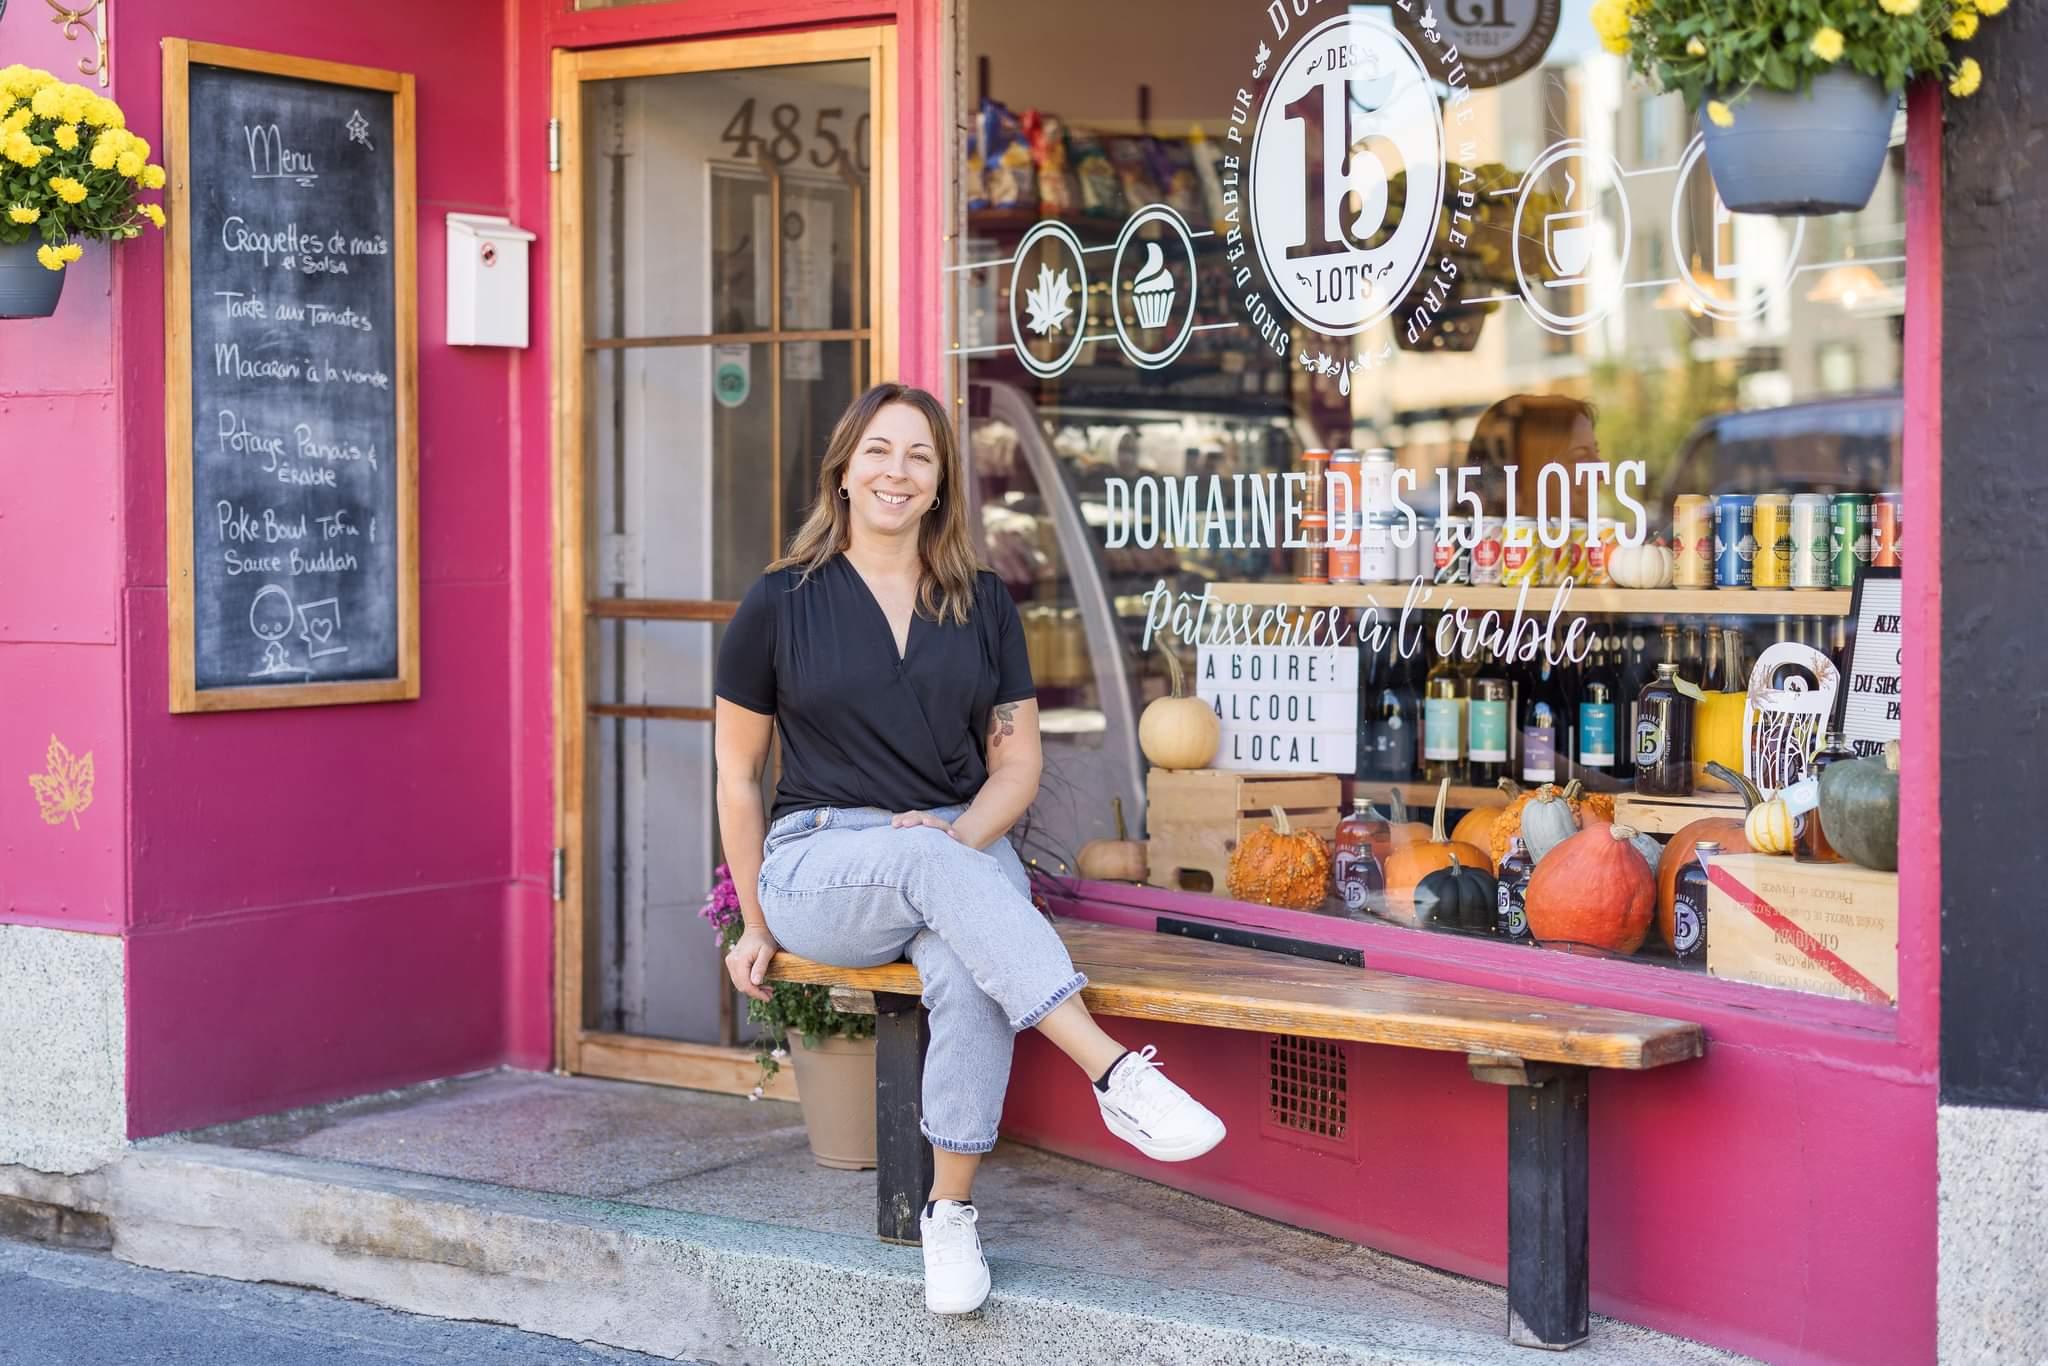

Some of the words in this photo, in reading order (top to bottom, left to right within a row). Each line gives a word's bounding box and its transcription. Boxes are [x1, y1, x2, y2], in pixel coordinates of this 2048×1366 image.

[1440, 45, 1473, 127] PURE
[1227, 87, 1253, 145] PUR
[244, 124, 315, 176] Menu
[1284, 79, 1408, 260] 15
[1448, 141, 1477, 249] MAPLE
[328, 230, 347, 255] de
[303, 254, 349, 274] Salsa
[1315, 263, 1373, 304] LOTS
[1406, 257, 1457, 344] SYRUP
[214, 288, 267, 320] Tarte
[275, 304, 305, 321] aux
[305, 303, 372, 331] Tomates
[1244, 291, 1290, 357] SIROP
[325, 358, 341, 383] la
[217, 409, 286, 472] Potage
[293, 423, 361, 463] Panais
[217, 500, 260, 544] Poke
[262, 508, 307, 543] Bowl
[315, 509, 360, 541] Tofu
[1104, 472, 1308, 550] DOMAINE
[1323, 468, 1417, 549] DES
[1435, 466, 1484, 549] 15
[1503, 459, 1648, 549] LOTS
[224, 549, 281, 576] Sauce
[1142, 579, 1352, 654] Pâtisseries
[1358, 593, 1392, 653] à
[1398, 575, 1596, 666] l'érable
[1873, 615, 1901, 633] AUX
[1205, 653, 1216, 680] A
[1854, 674, 1873, 692] DU
[1213, 693, 1316, 722] ALCOOL
[1234, 734, 1319, 763] LOCAL
[1637, 730, 1657, 754] 15
[1348, 887, 1360, 902] 15
[1509, 911, 1522, 927] 15
[1674, 911, 1692, 938] 15
